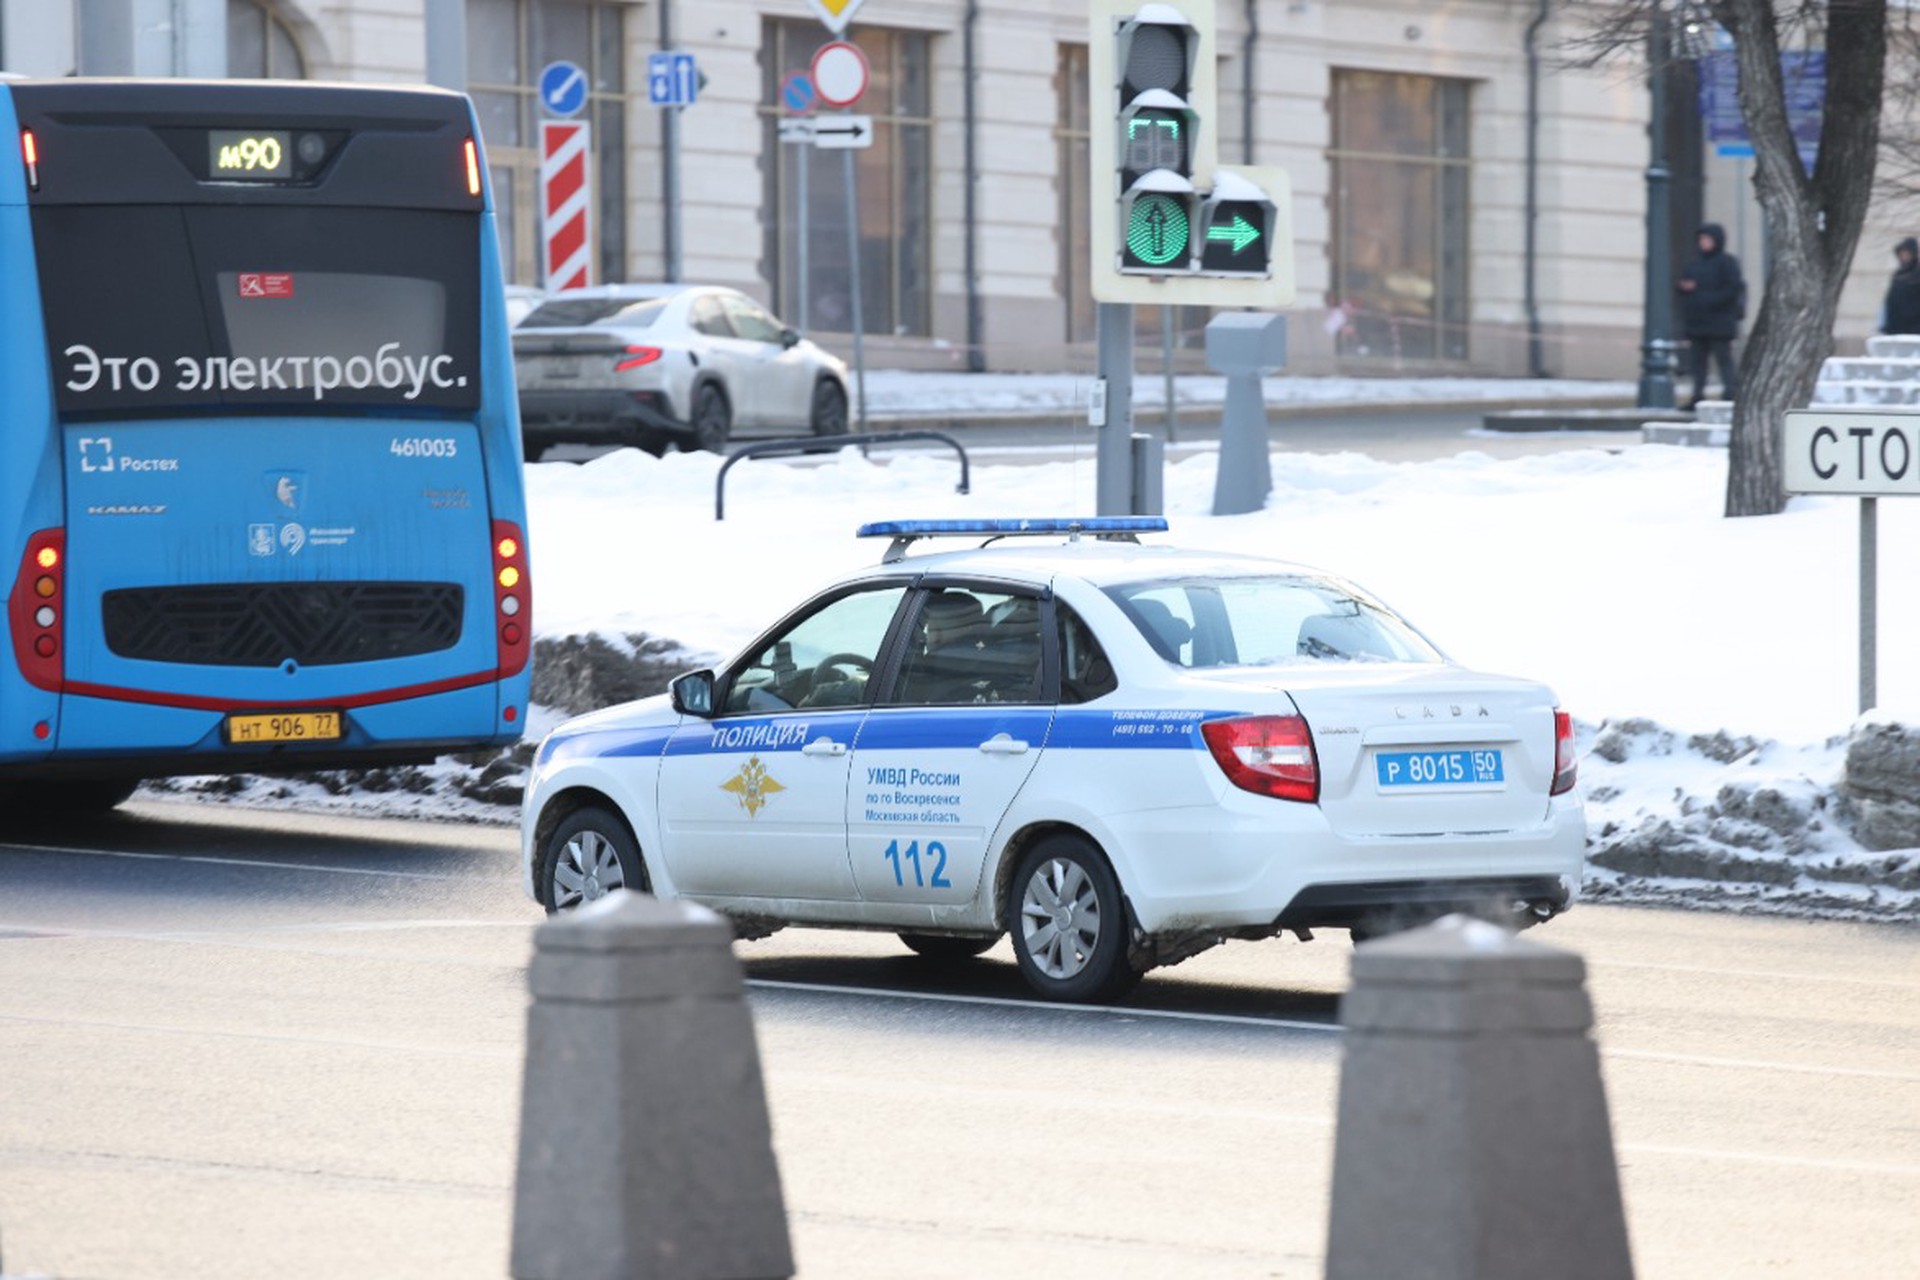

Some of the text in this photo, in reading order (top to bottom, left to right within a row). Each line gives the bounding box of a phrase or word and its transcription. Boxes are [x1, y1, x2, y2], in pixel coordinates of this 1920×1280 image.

[64, 342, 467, 400] Это электробус.
[390, 438, 457, 457] 461003
[1810, 426, 1920, 480] СТО
[120, 456, 179, 472] Ростех
[271, 716, 305, 738] 906
[315, 714, 332, 731] 77
[711, 723, 810, 750] ПОЛИЦИЯ
[866, 767, 960, 788] УМВД России
[1387, 752, 1497, 782] Р 8015 50
[894, 791, 961, 807] Воскресенск
[885, 839, 952, 889] 112
